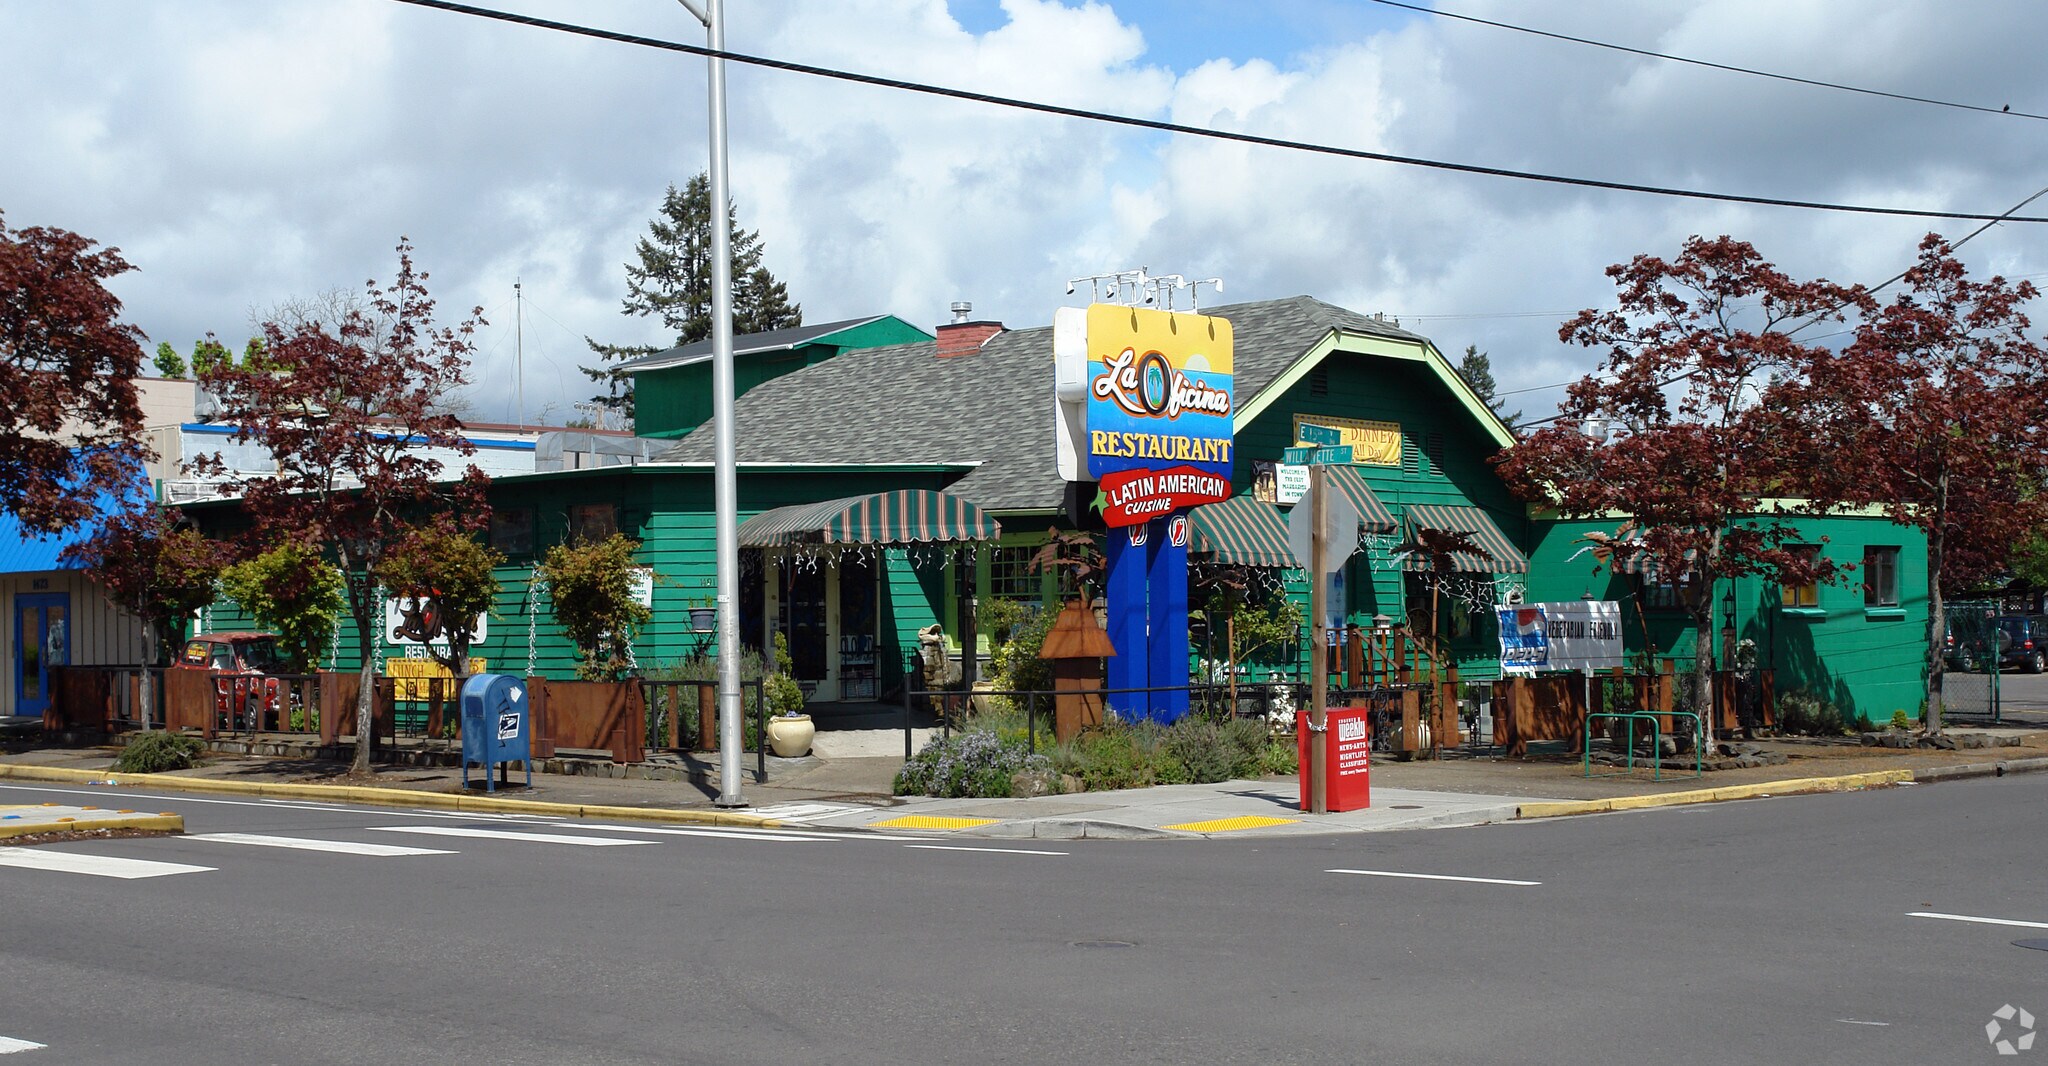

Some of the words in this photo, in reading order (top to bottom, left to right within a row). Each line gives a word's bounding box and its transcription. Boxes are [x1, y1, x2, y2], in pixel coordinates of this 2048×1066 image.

[1095, 349, 1147, 404] La
[1138, 352, 1229, 417] Oficina
[1300, 426, 1305, 439] E
[1351, 427, 1395, 444] DINNER
[1091, 430, 1233, 463] RESTAURANT
[1353, 444, 1365, 456] All
[1368, 445, 1383, 459] Day
[1286, 449, 1335, 463] WILLAMETTE
[1112, 476, 1155, 507] LATIN
[1158, 475, 1225, 498] AMERICAN
[1125, 498, 1171, 516] CUISINE
[1548, 621, 1584, 639] VEGETARIAN
[1589, 621, 1618, 640] FRIENDLY
[1504, 646, 1548, 662] PEPSI
[1340, 751, 1367, 761] NIGHTLIFE
